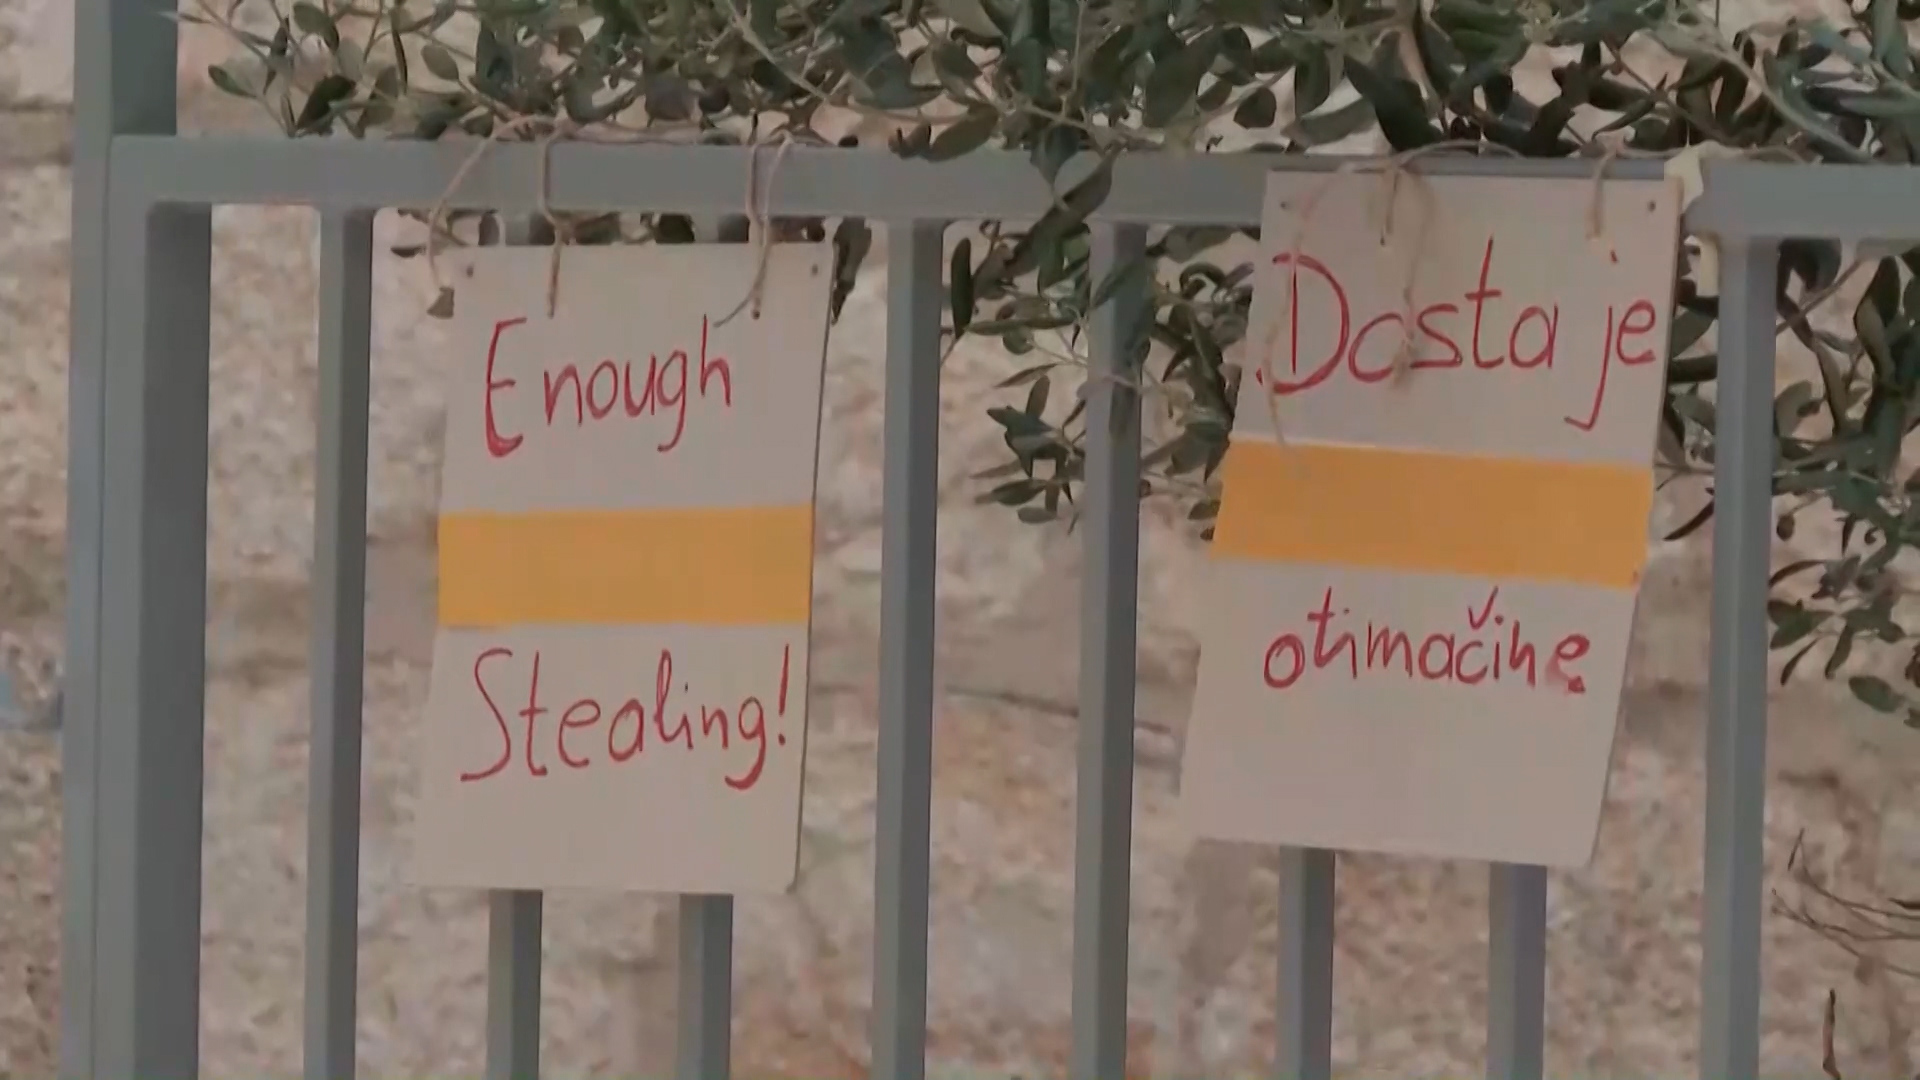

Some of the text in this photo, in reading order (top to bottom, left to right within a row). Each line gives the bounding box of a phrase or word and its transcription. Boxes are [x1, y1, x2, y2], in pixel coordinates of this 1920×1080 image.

[485, 315, 732, 458] Enough
[1256, 235, 1656, 430] Dosta je
[1263, 586, 1590, 694] otimačine
[461, 645, 790, 791] Stealing!
